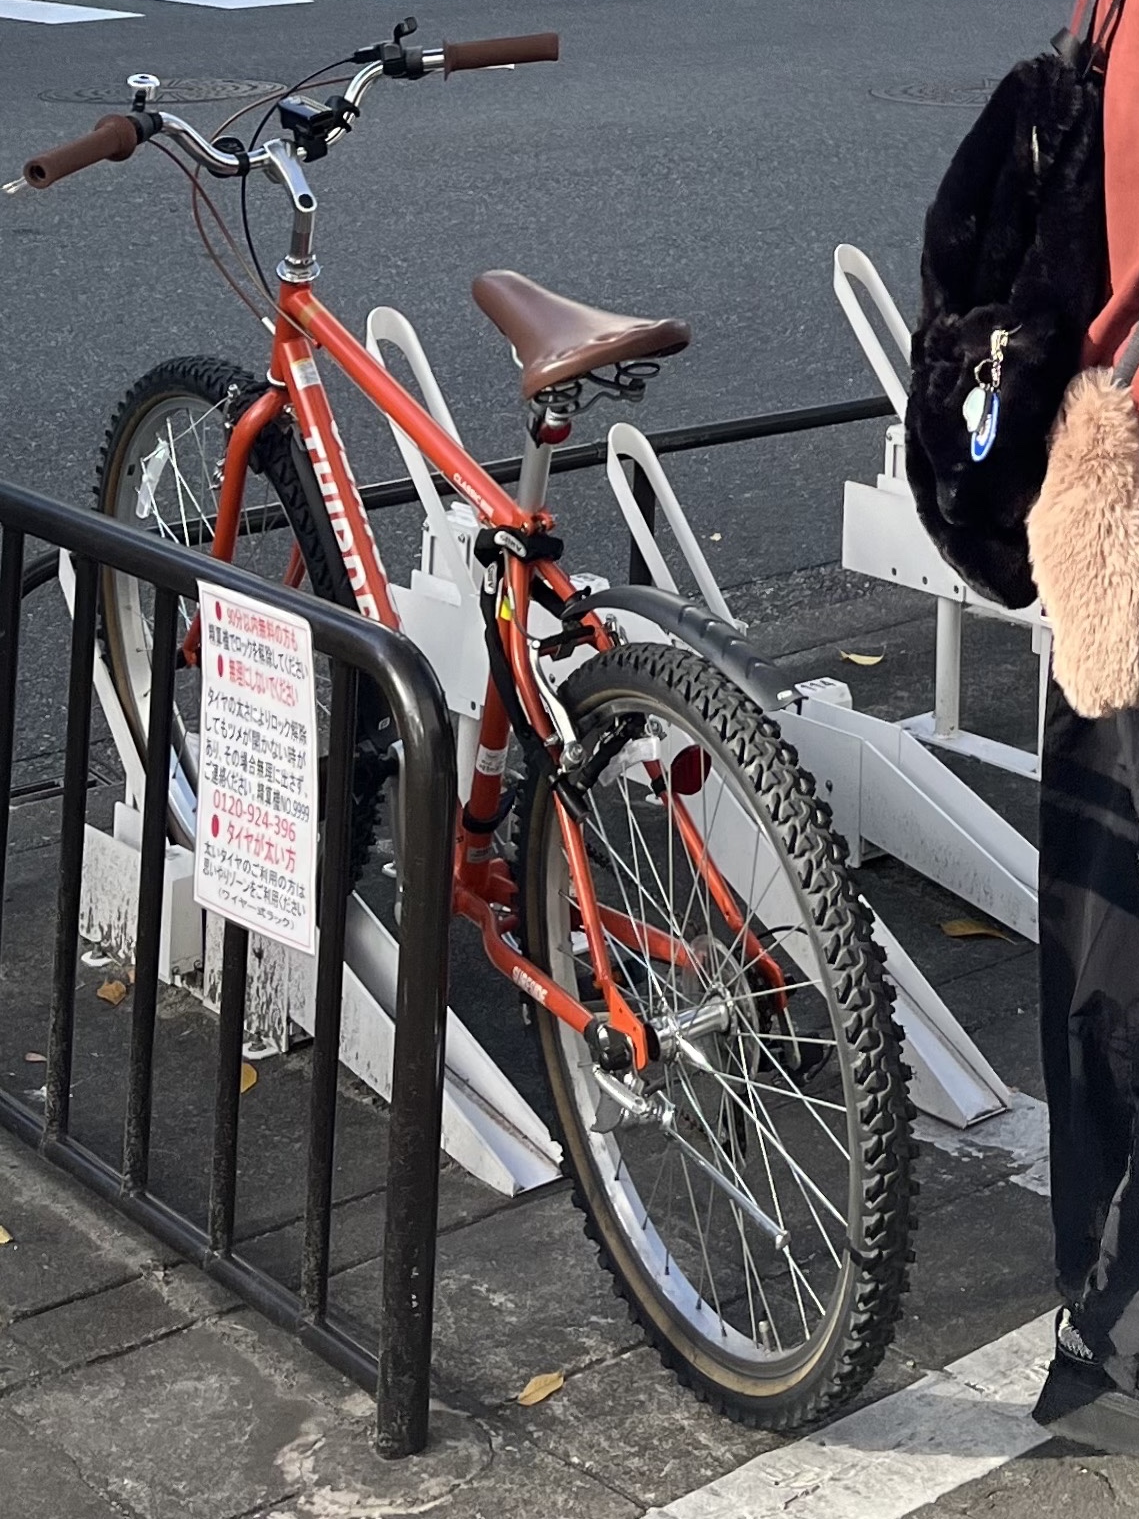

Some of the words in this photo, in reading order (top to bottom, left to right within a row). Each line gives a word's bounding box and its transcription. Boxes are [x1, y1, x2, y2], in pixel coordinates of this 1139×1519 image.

[213, 788, 295, 843] 0120-924-396
[227, 820, 296, 875] タイヤが太い方
